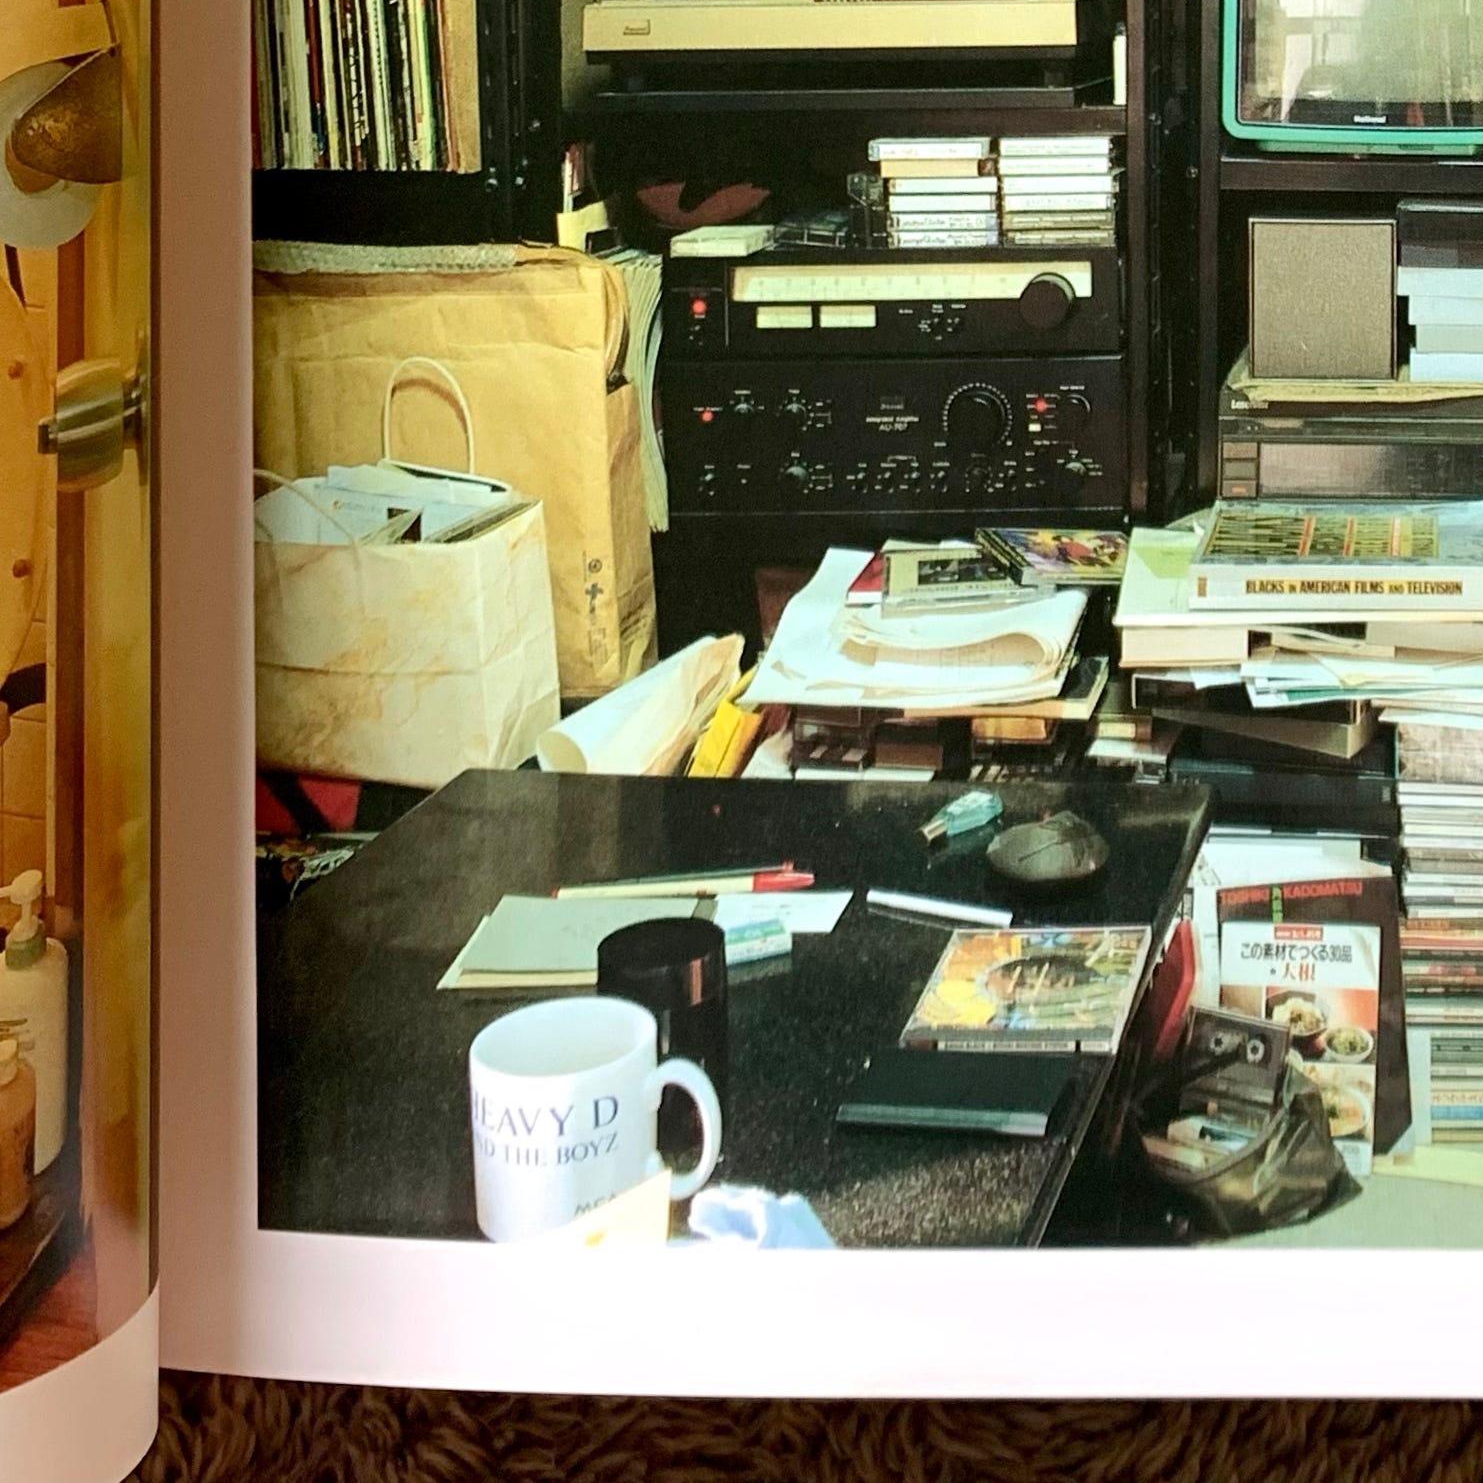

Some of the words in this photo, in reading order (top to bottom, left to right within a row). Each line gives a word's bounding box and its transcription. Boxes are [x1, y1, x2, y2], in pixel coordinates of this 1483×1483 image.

[1246, 580, 1285, 595] BLACKS
[1300, 580, 1351, 595] AMERICAN
[1354, 580, 1384, 595] FILMS
[1389, 583, 1405, 595] AND
[1407, 580, 1463, 595] TELEVISION
[1282, 878, 1363, 899] KADOMATSU
[593, 1094, 619, 1129] D
[476, 1132, 496, 1158] ND
[505, 1144, 548, 1167] THE
[556, 1130, 619, 1166] BOYZ
